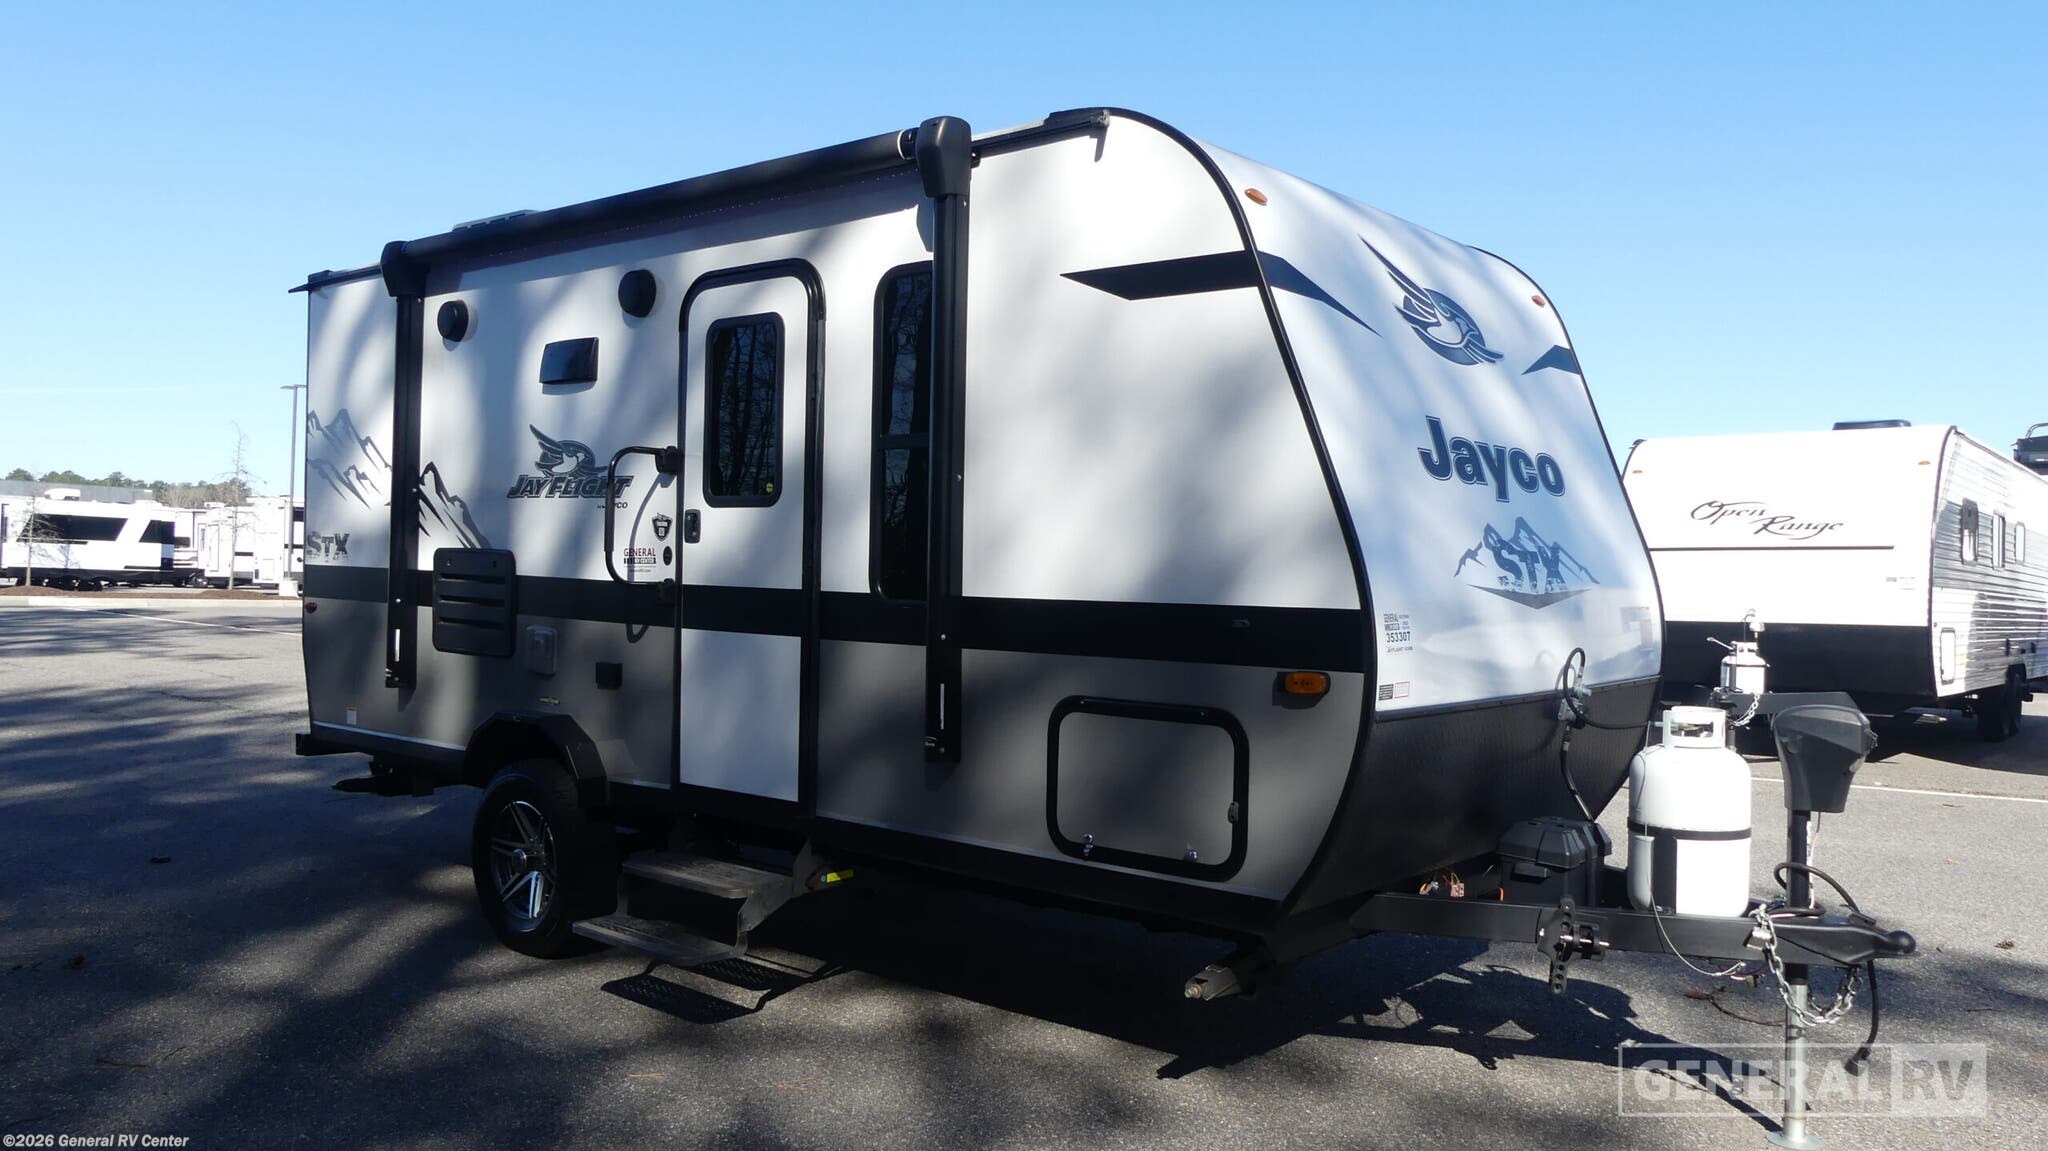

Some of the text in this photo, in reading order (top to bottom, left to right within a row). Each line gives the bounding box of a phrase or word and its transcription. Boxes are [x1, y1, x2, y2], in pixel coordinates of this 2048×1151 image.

[1417, 415, 1565, 503] Jayco
[1690, 500, 1766, 525] Open
[1749, 516, 1844, 541] Range
[307, 531, 350, 562] STX
[624, 548, 656, 557] GENERAL
[1492, 538, 1567, 593] STX
[1386, 631, 1411, 643] 353307
